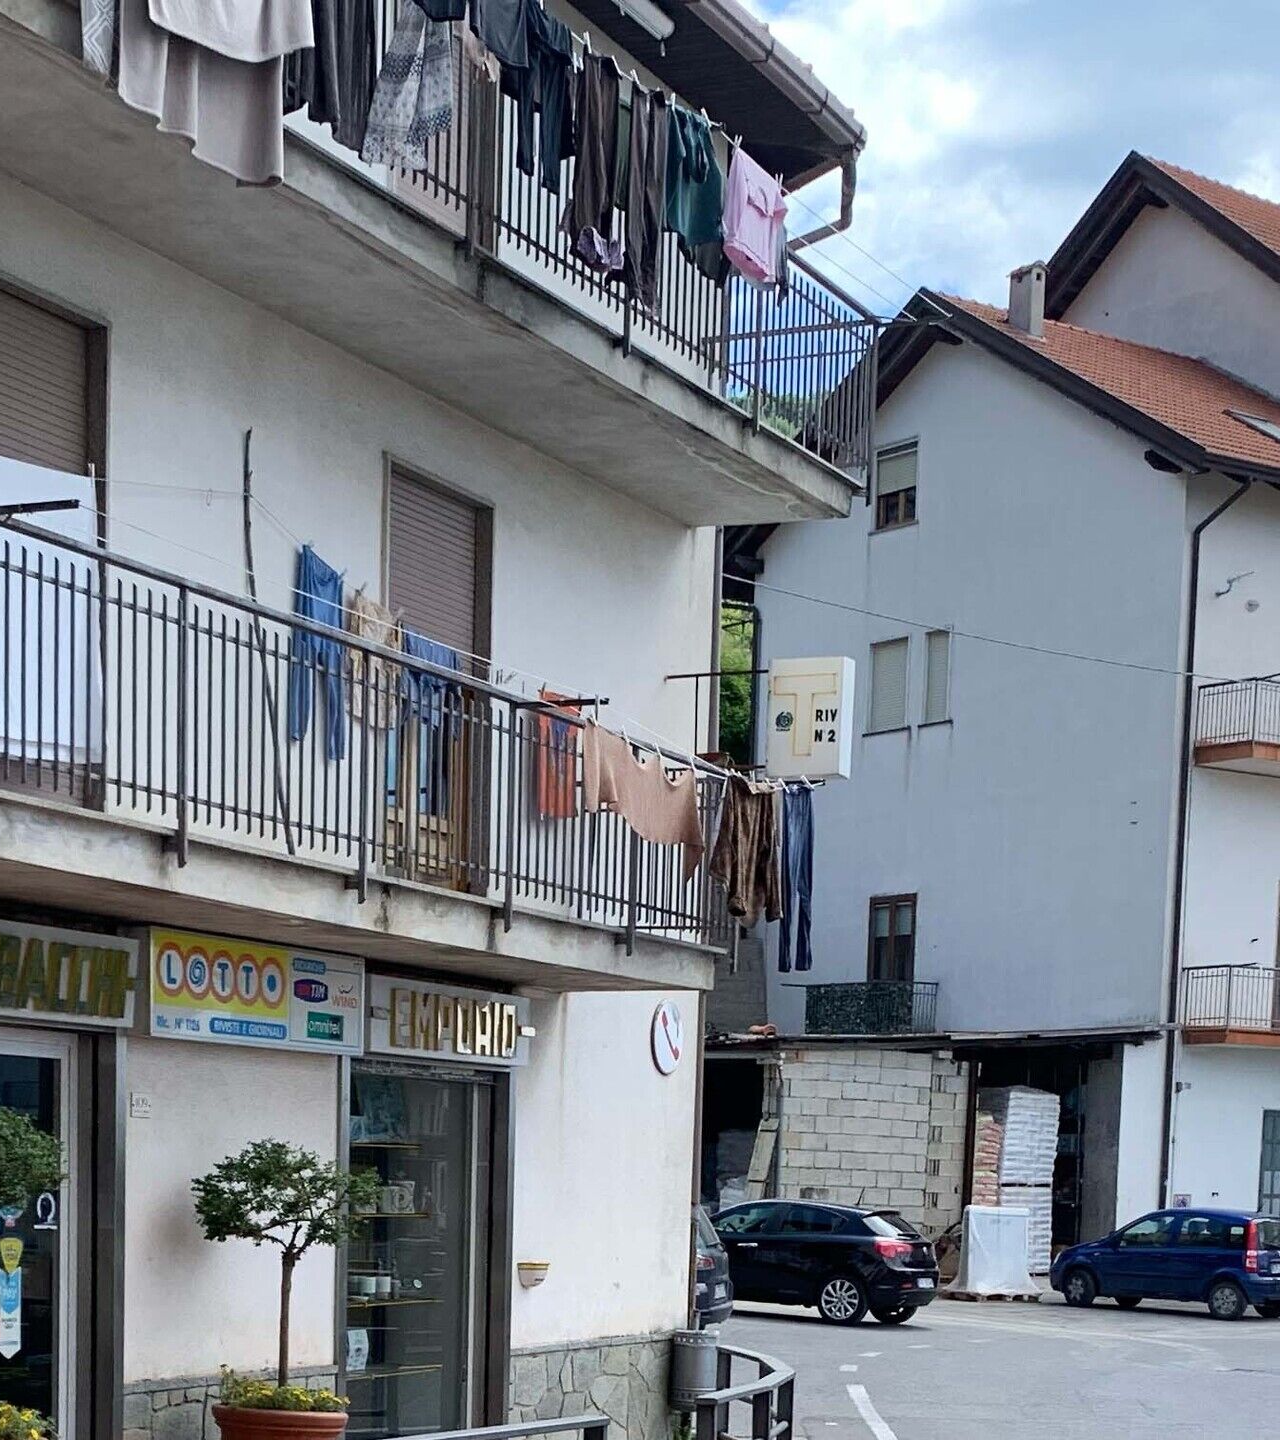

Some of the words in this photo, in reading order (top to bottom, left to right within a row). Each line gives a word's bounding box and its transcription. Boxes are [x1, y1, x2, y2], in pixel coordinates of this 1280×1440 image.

[815, 708, 838, 722] RIV
[827, 729, 836, 742] 2
[159, 944, 285, 1005] LOTTO
[331, 995, 358, 1009] WIND
[248, 1023, 284, 1038] GIORNALI
[308, 1019, 340, 1035] omnitel
